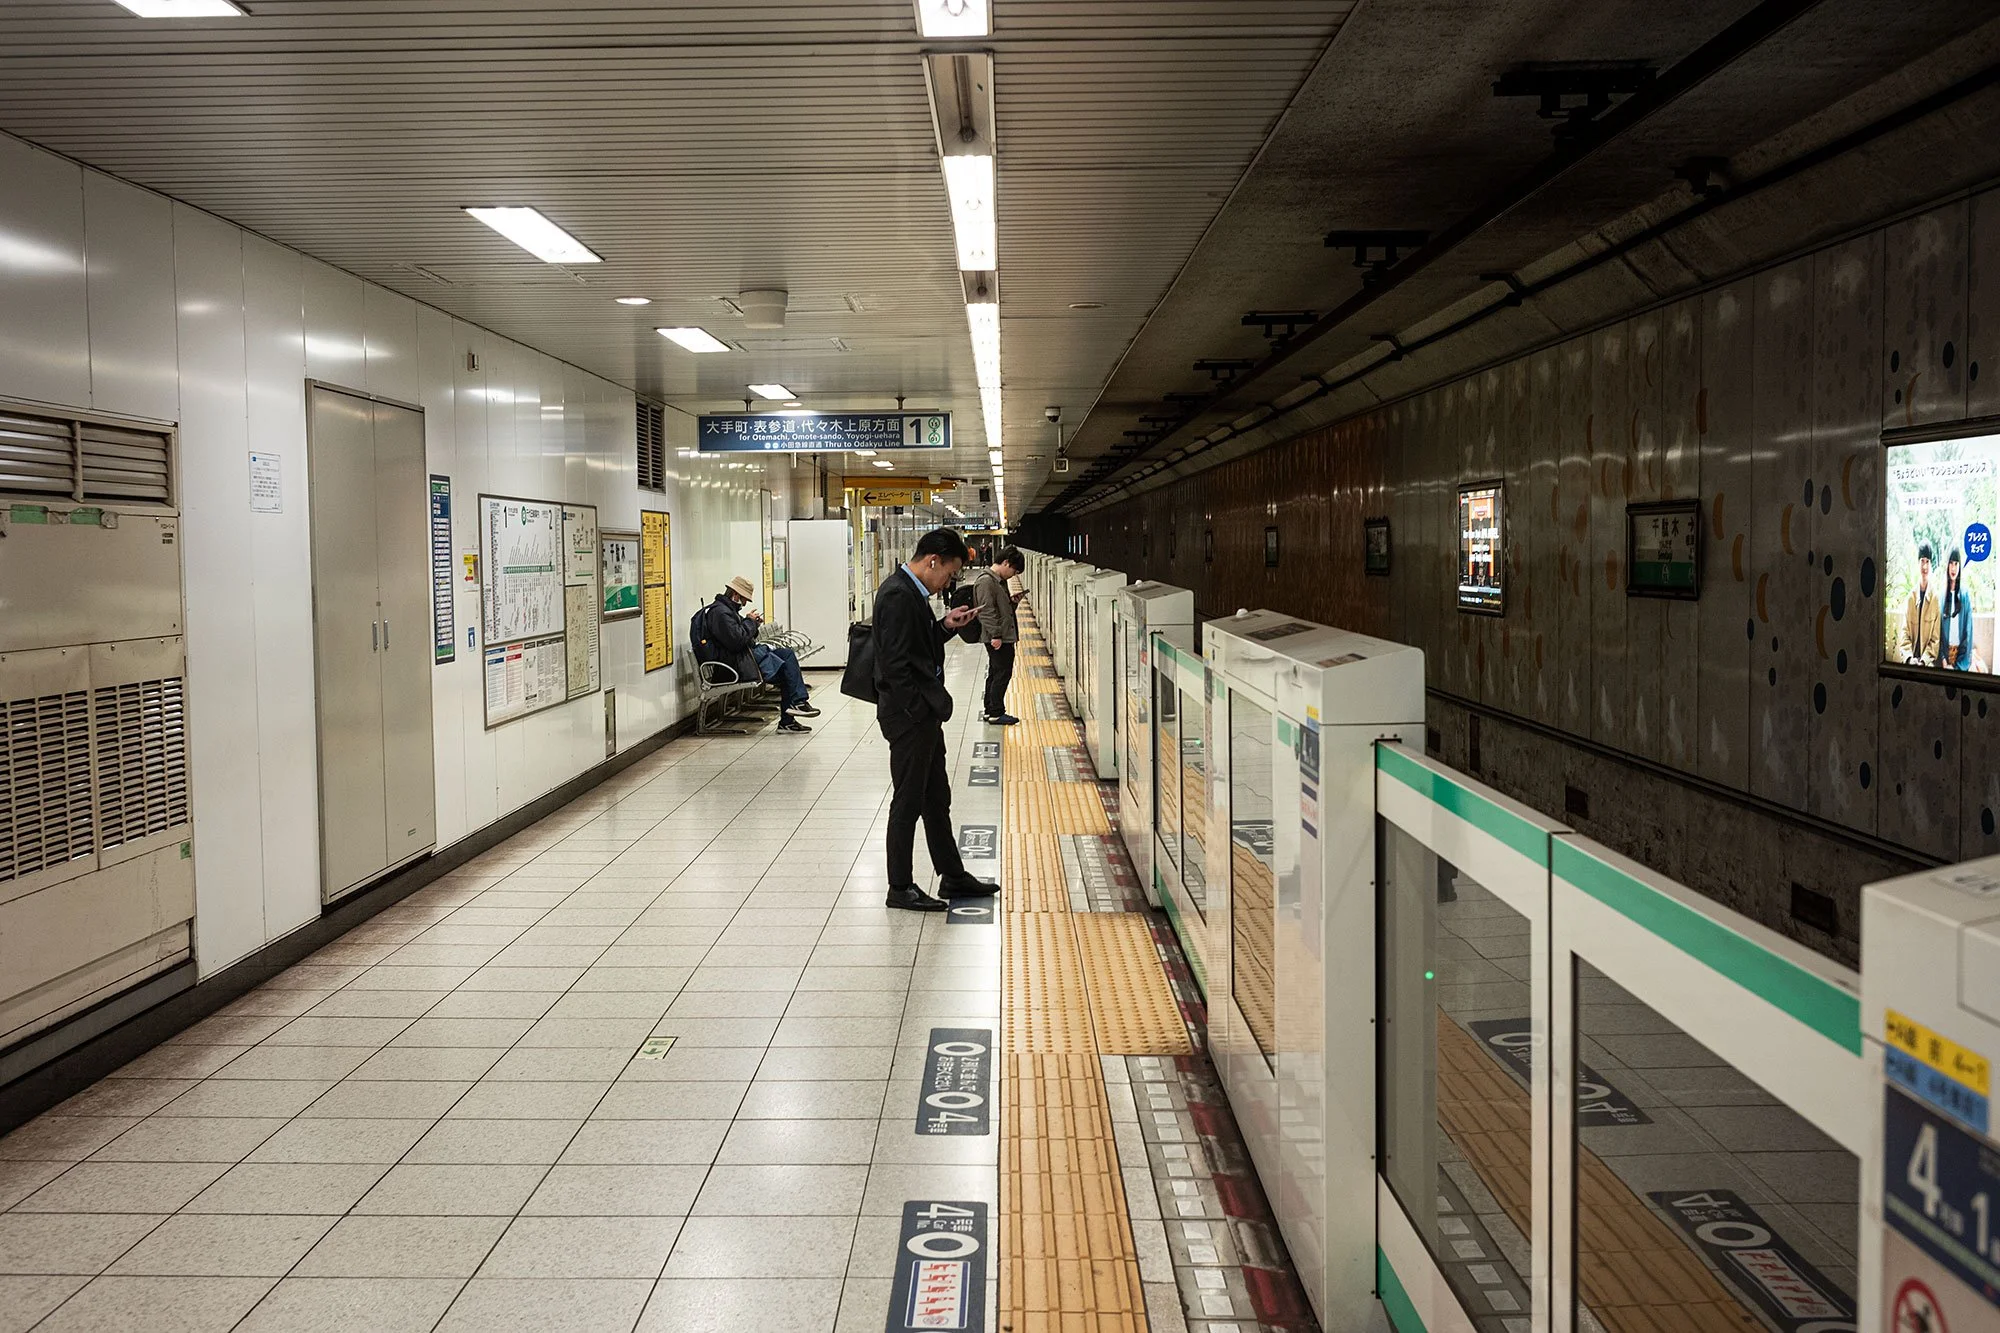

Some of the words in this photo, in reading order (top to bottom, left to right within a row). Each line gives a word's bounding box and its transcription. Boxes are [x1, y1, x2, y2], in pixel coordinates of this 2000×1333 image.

[909, 418, 922, 444] 1
[752, 433, 790, 442] Otemachi,
[792, 433, 844, 441] Omote-sando,
[846, 432, 900, 441] Yoyogi-uehara
[854, 440, 883, 449] Odakyu
